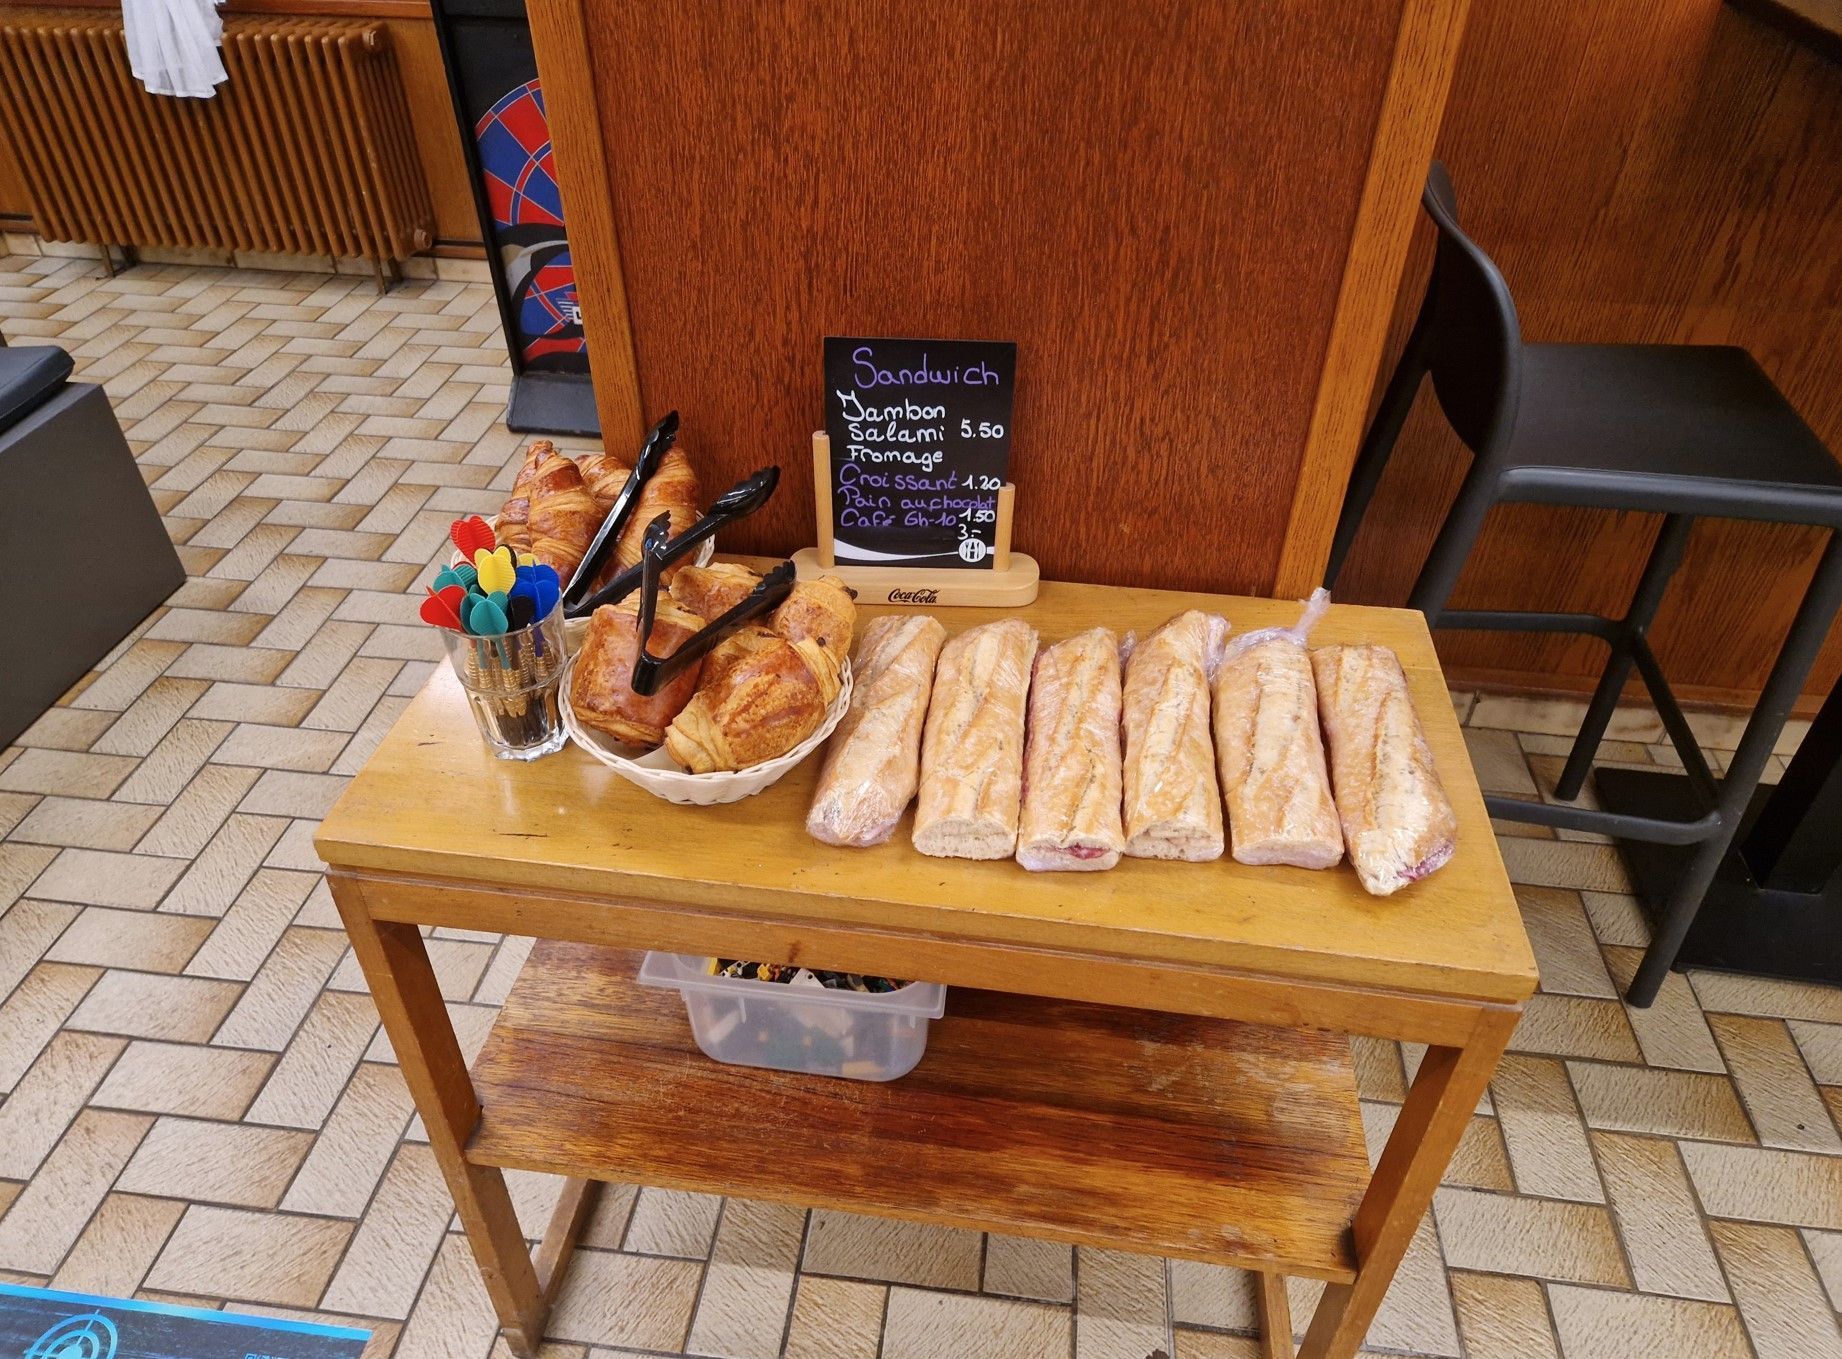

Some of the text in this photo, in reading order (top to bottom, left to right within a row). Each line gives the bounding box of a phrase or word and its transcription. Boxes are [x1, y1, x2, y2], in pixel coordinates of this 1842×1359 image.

[852, 347, 999, 388] Sandwich
[836, 389, 945, 422] Jambon
[848, 418, 1004, 443] Salami 5.50
[846, 444, 943, 472] Fromage
[839, 463, 1001, 490] Croissant 1.20
[837, 485, 891, 508] Pain
[959, 507, 996, 522] 1.50
[888, 588, 940, 603] Coca-Cola
